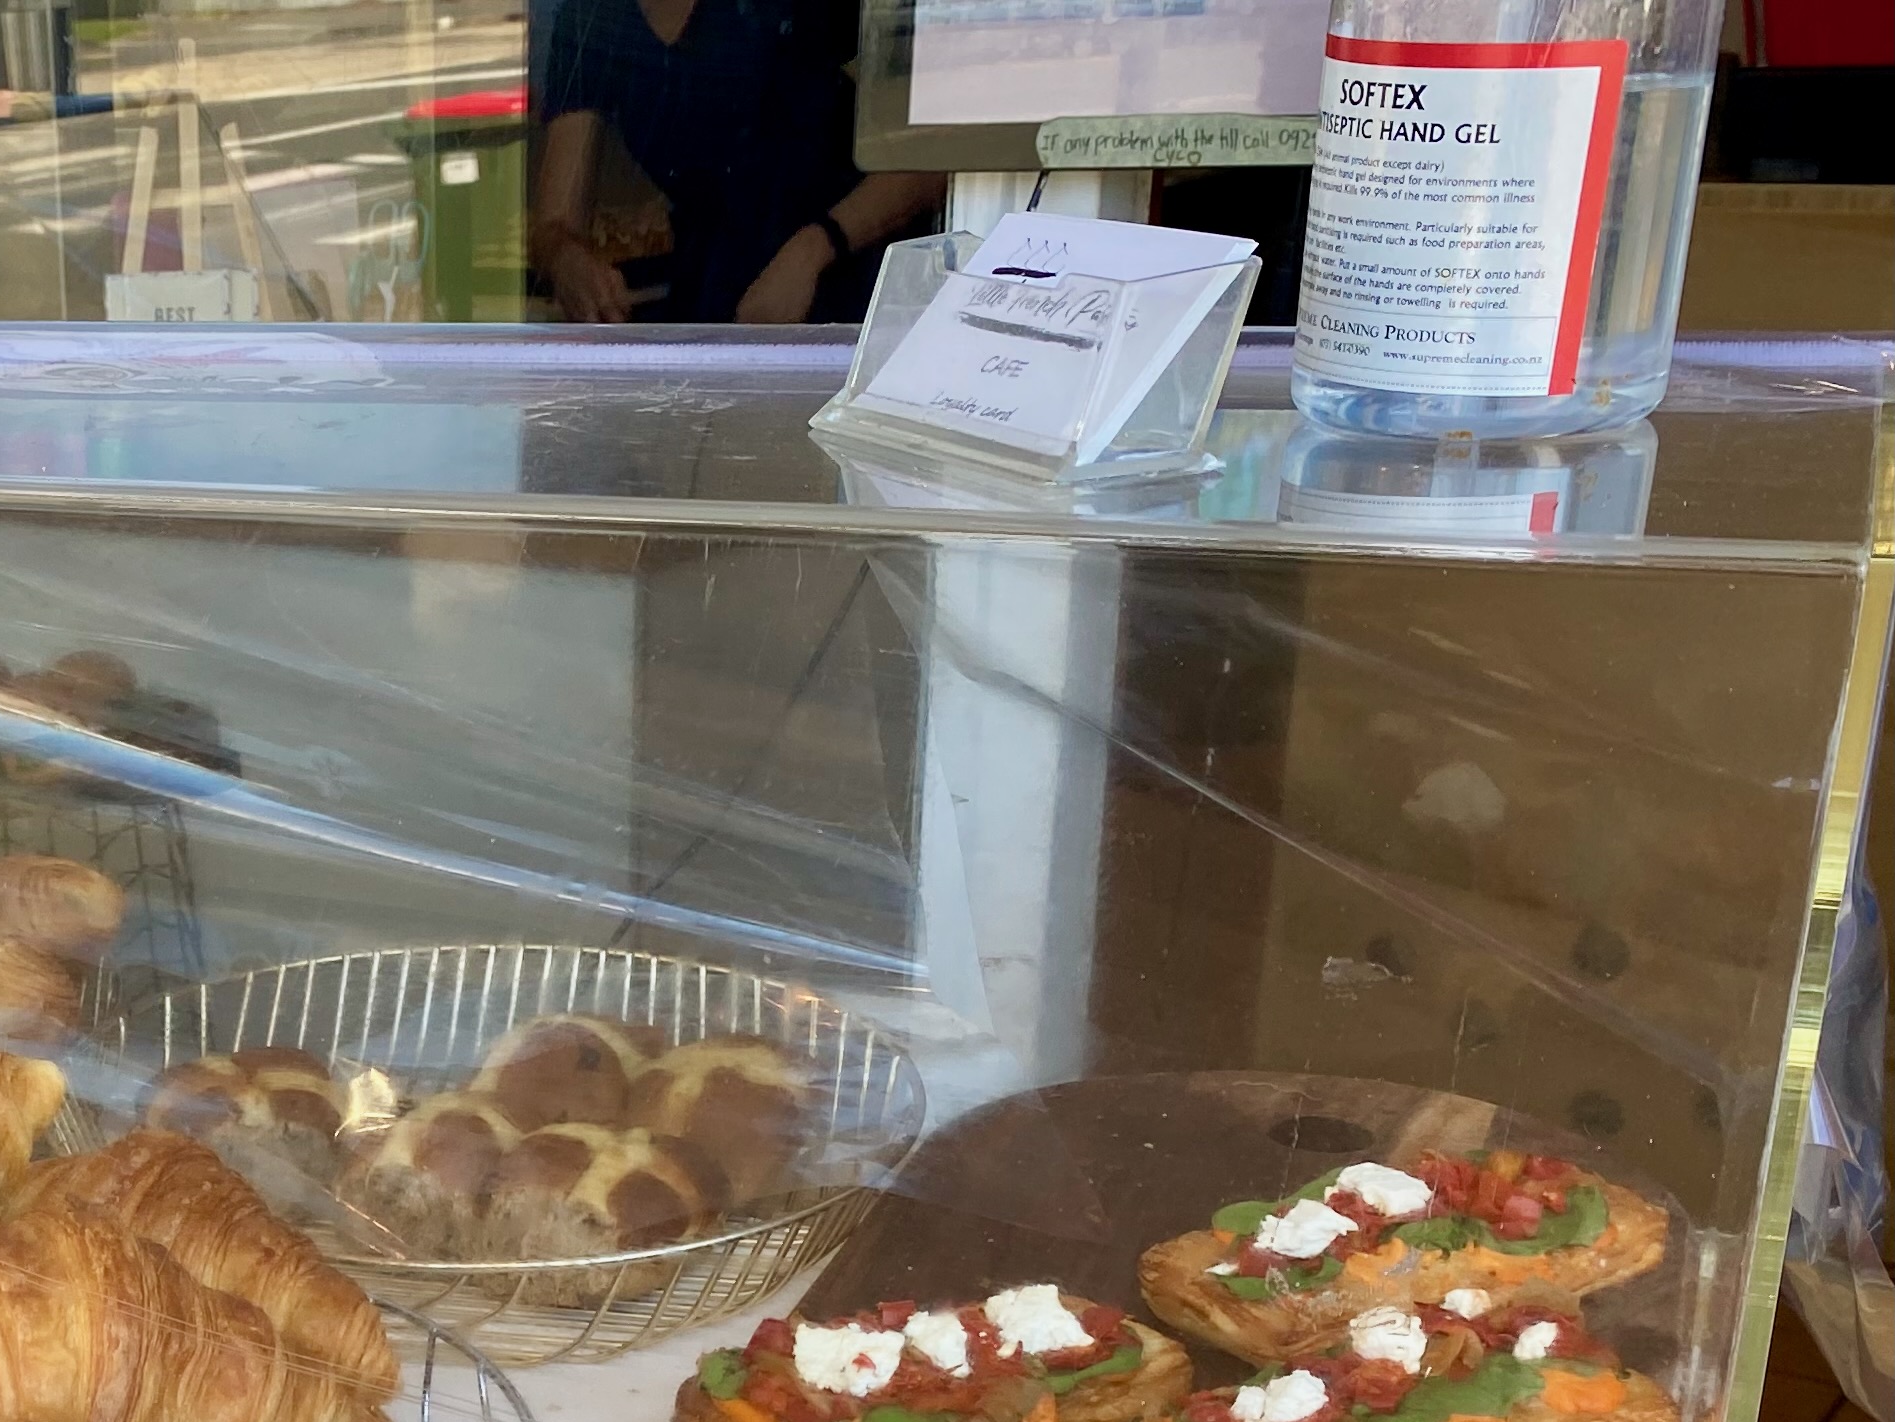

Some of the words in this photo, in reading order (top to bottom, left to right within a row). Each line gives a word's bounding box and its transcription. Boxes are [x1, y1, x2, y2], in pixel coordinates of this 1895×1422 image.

[1340, 78, 1428, 111] SOFTEX
[1379, 120, 1445, 143] HAND
[1454, 123, 1501, 144] GEL
[1064, 136, 1090, 156] any
[1095, 130, 1154, 156] problem
[1159, 128, 1188, 149] with
[1193, 128, 1214, 147] the
[1243, 131, 1270, 150] call
[1351, 155, 1381, 167] product
[1382, 160, 1412, 171] except
[1415, 159, 1445, 173] dairy)
[1368, 172, 1405, 185] designed
[1408, 174, 1421, 186] for
[1426, 177, 1497, 189] environments
[1502, 177, 1535, 188] where
[1391, 189, 1402, 200] of
[1404, 190, 1420, 201] the
[1423, 192, 1447, 202] most
[1451, 193, 1500, 203] common
[1503, 192, 1535, 203] illness
[1415, 221, 1473, 237] Particularly
[1476, 223, 1518, 235] suitable
[1522, 223, 1538, 235] for
[1349, 231, 1383, 245] required
[1385, 235, 1406, 246] such
[1409, 237, 1418, 247] as
[1421, 236, 1445, 248] food
[1448, 238, 1511, 252] preparation
[1515, 240, 1546, 253] areas,
[1381, 265, 1417, 278] amount
[1420, 267, 1431, 278] of
[1434, 268, 1481, 280] SOFTEX
[1484, 270, 1510, 280] onto
[1514, 269, 1546, 280] hands
[1344, 274, 1353, 285] of
[1354, 276, 1366, 287] the
[1369, 278, 1394, 290] hands
[1397, 282, 1412, 291] are
[1415, 283, 1472, 296] completely
[1475, 284, 1521, 295] covered.
[1355, 292, 1381, 305] rinsing
[1383, 296, 1394, 304] or
[1396, 296, 1441, 310] towelling
[1459, 299, 1508, 311] required.
[980, 355, 1029, 378] CAFE
[1382, 350, 1543, 367] www.supremecleaning.co.nz
